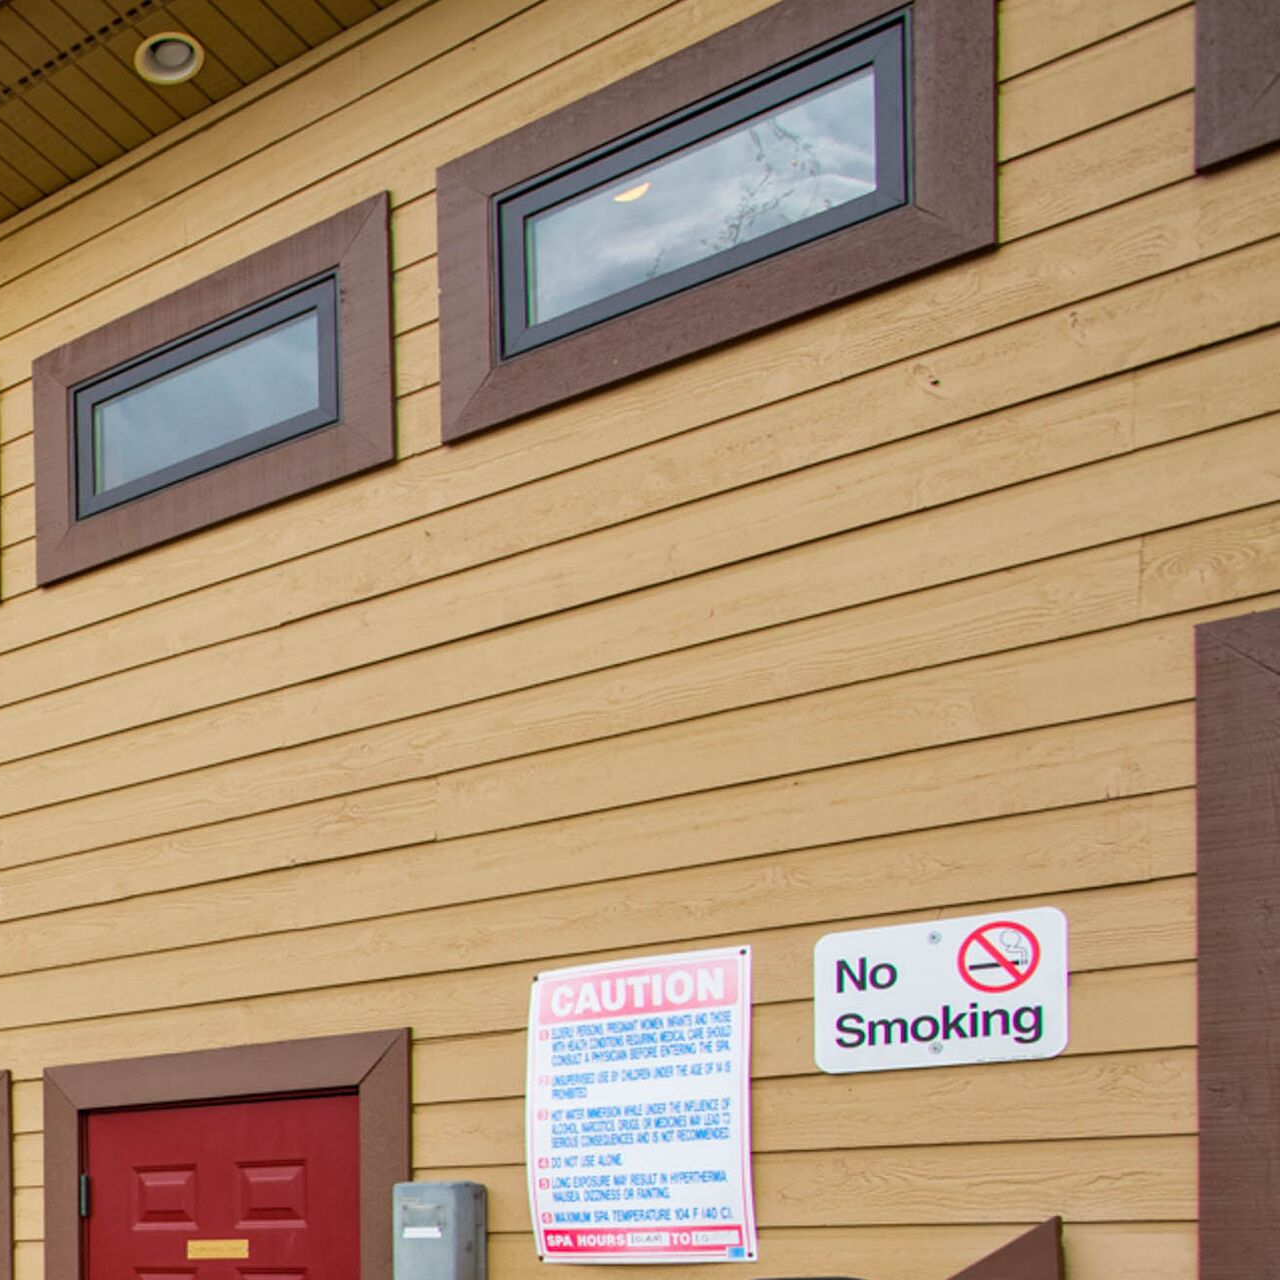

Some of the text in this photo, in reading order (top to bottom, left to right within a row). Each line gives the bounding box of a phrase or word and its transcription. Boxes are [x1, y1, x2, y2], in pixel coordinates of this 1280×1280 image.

[836, 957, 898, 993] No
[551, 967, 725, 1017] CAUTION
[835, 1002, 1044, 1049] Smoking
[551, 1177, 572, 1190] LONG
[573, 1175, 611, 1189] EXPOSURE
[629, 1173, 658, 1186] RESULT
[554, 1211, 591, 1224] MAXIMUM
[612, 1209, 671, 1222] TEMPERATURE
[547, 1234, 573, 1247] SPA
[576, 1232, 626, 1247] HOURS
[671, 1231, 691, 1245] TO
